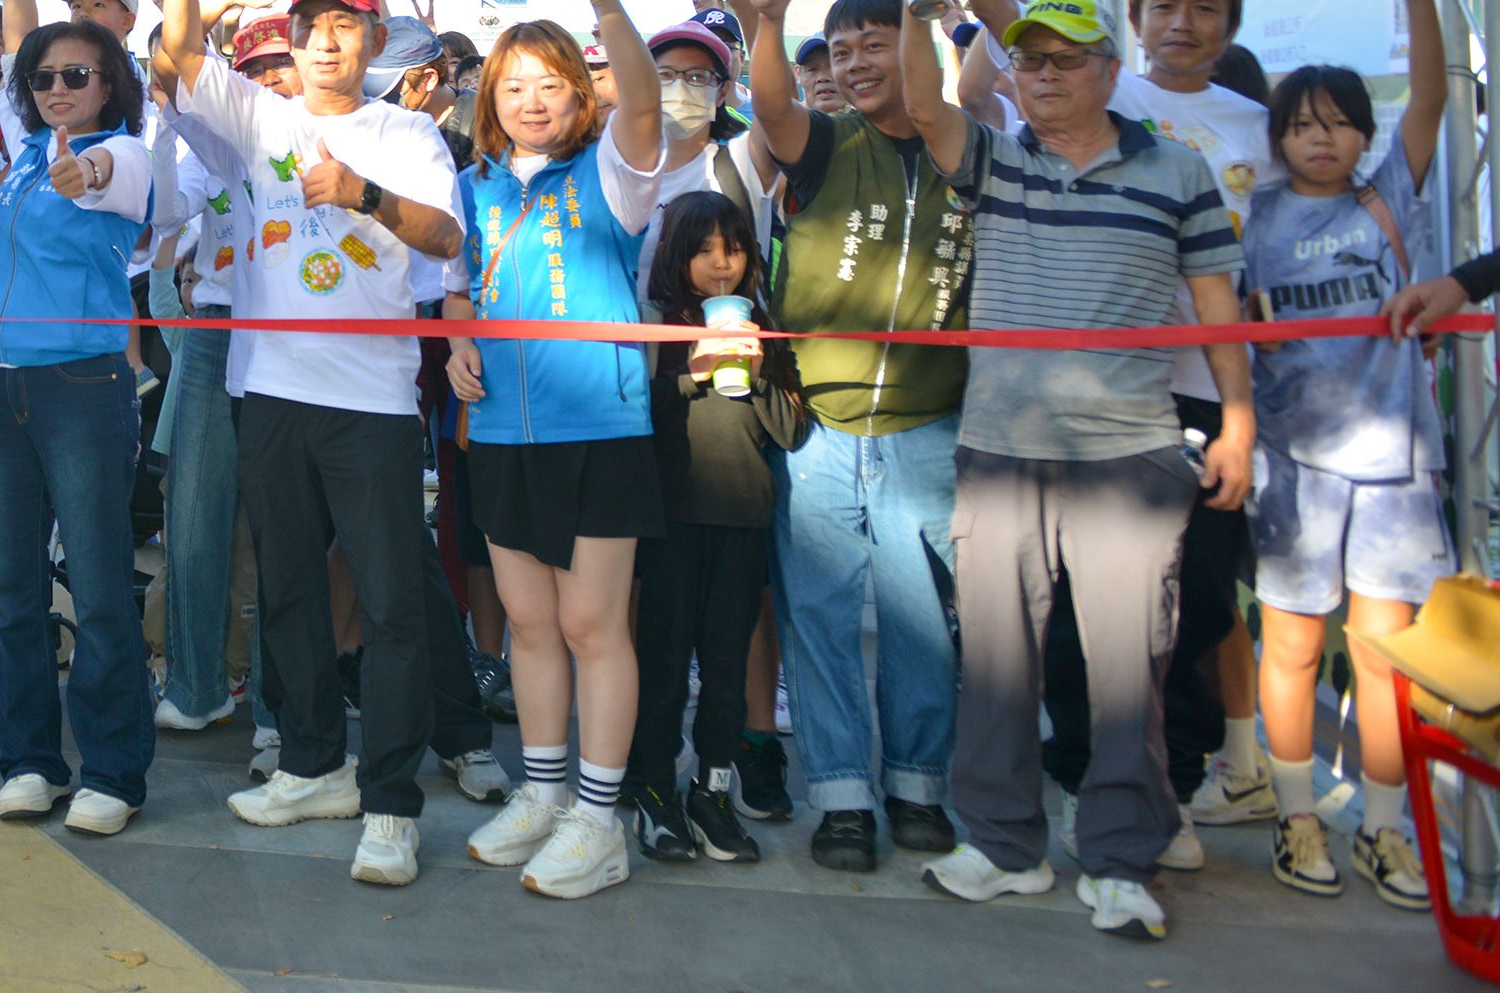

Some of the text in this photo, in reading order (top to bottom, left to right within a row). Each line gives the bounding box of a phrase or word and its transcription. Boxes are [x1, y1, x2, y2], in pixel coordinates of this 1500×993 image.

[266, 194, 299, 210] Let's
[299, 215, 322, 239] 後
[1294, 227, 1366, 260] Urban
[1270, 272, 1380, 314] PUMA
